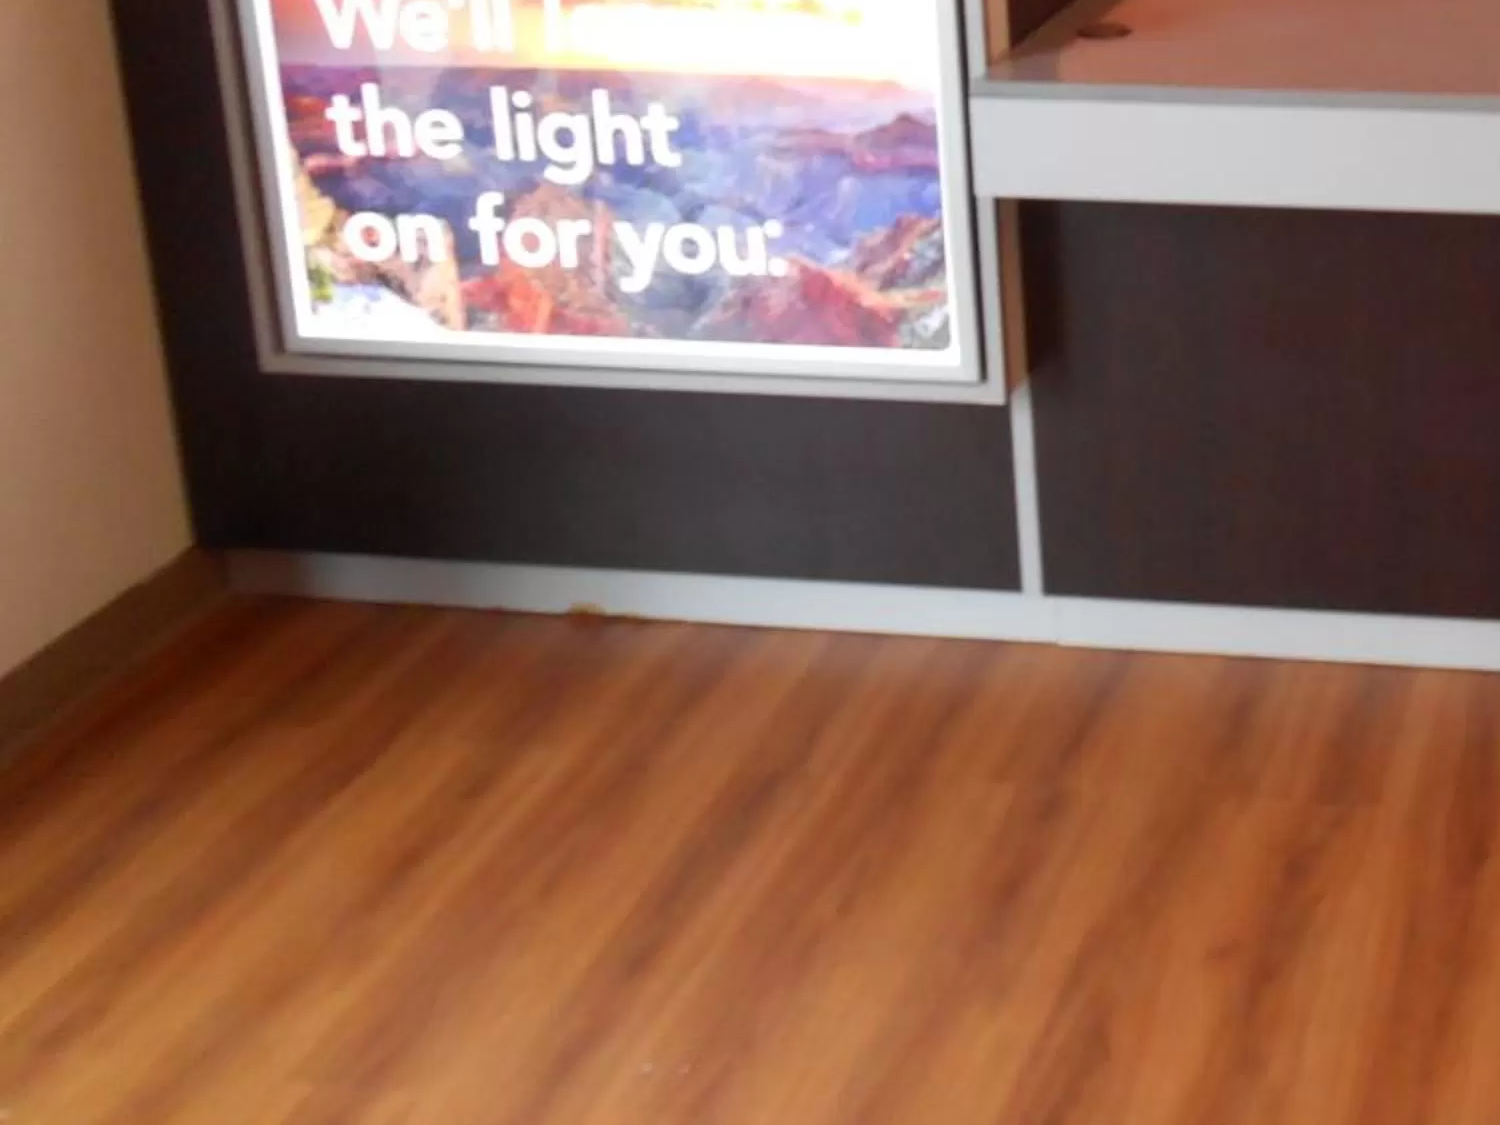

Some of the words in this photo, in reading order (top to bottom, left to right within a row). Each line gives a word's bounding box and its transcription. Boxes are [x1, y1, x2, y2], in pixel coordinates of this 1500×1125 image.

[325, 84, 463, 158] the
[489, 87, 683, 185] light
[343, 210, 447, 263] on
[468, 192, 593, 269] for
